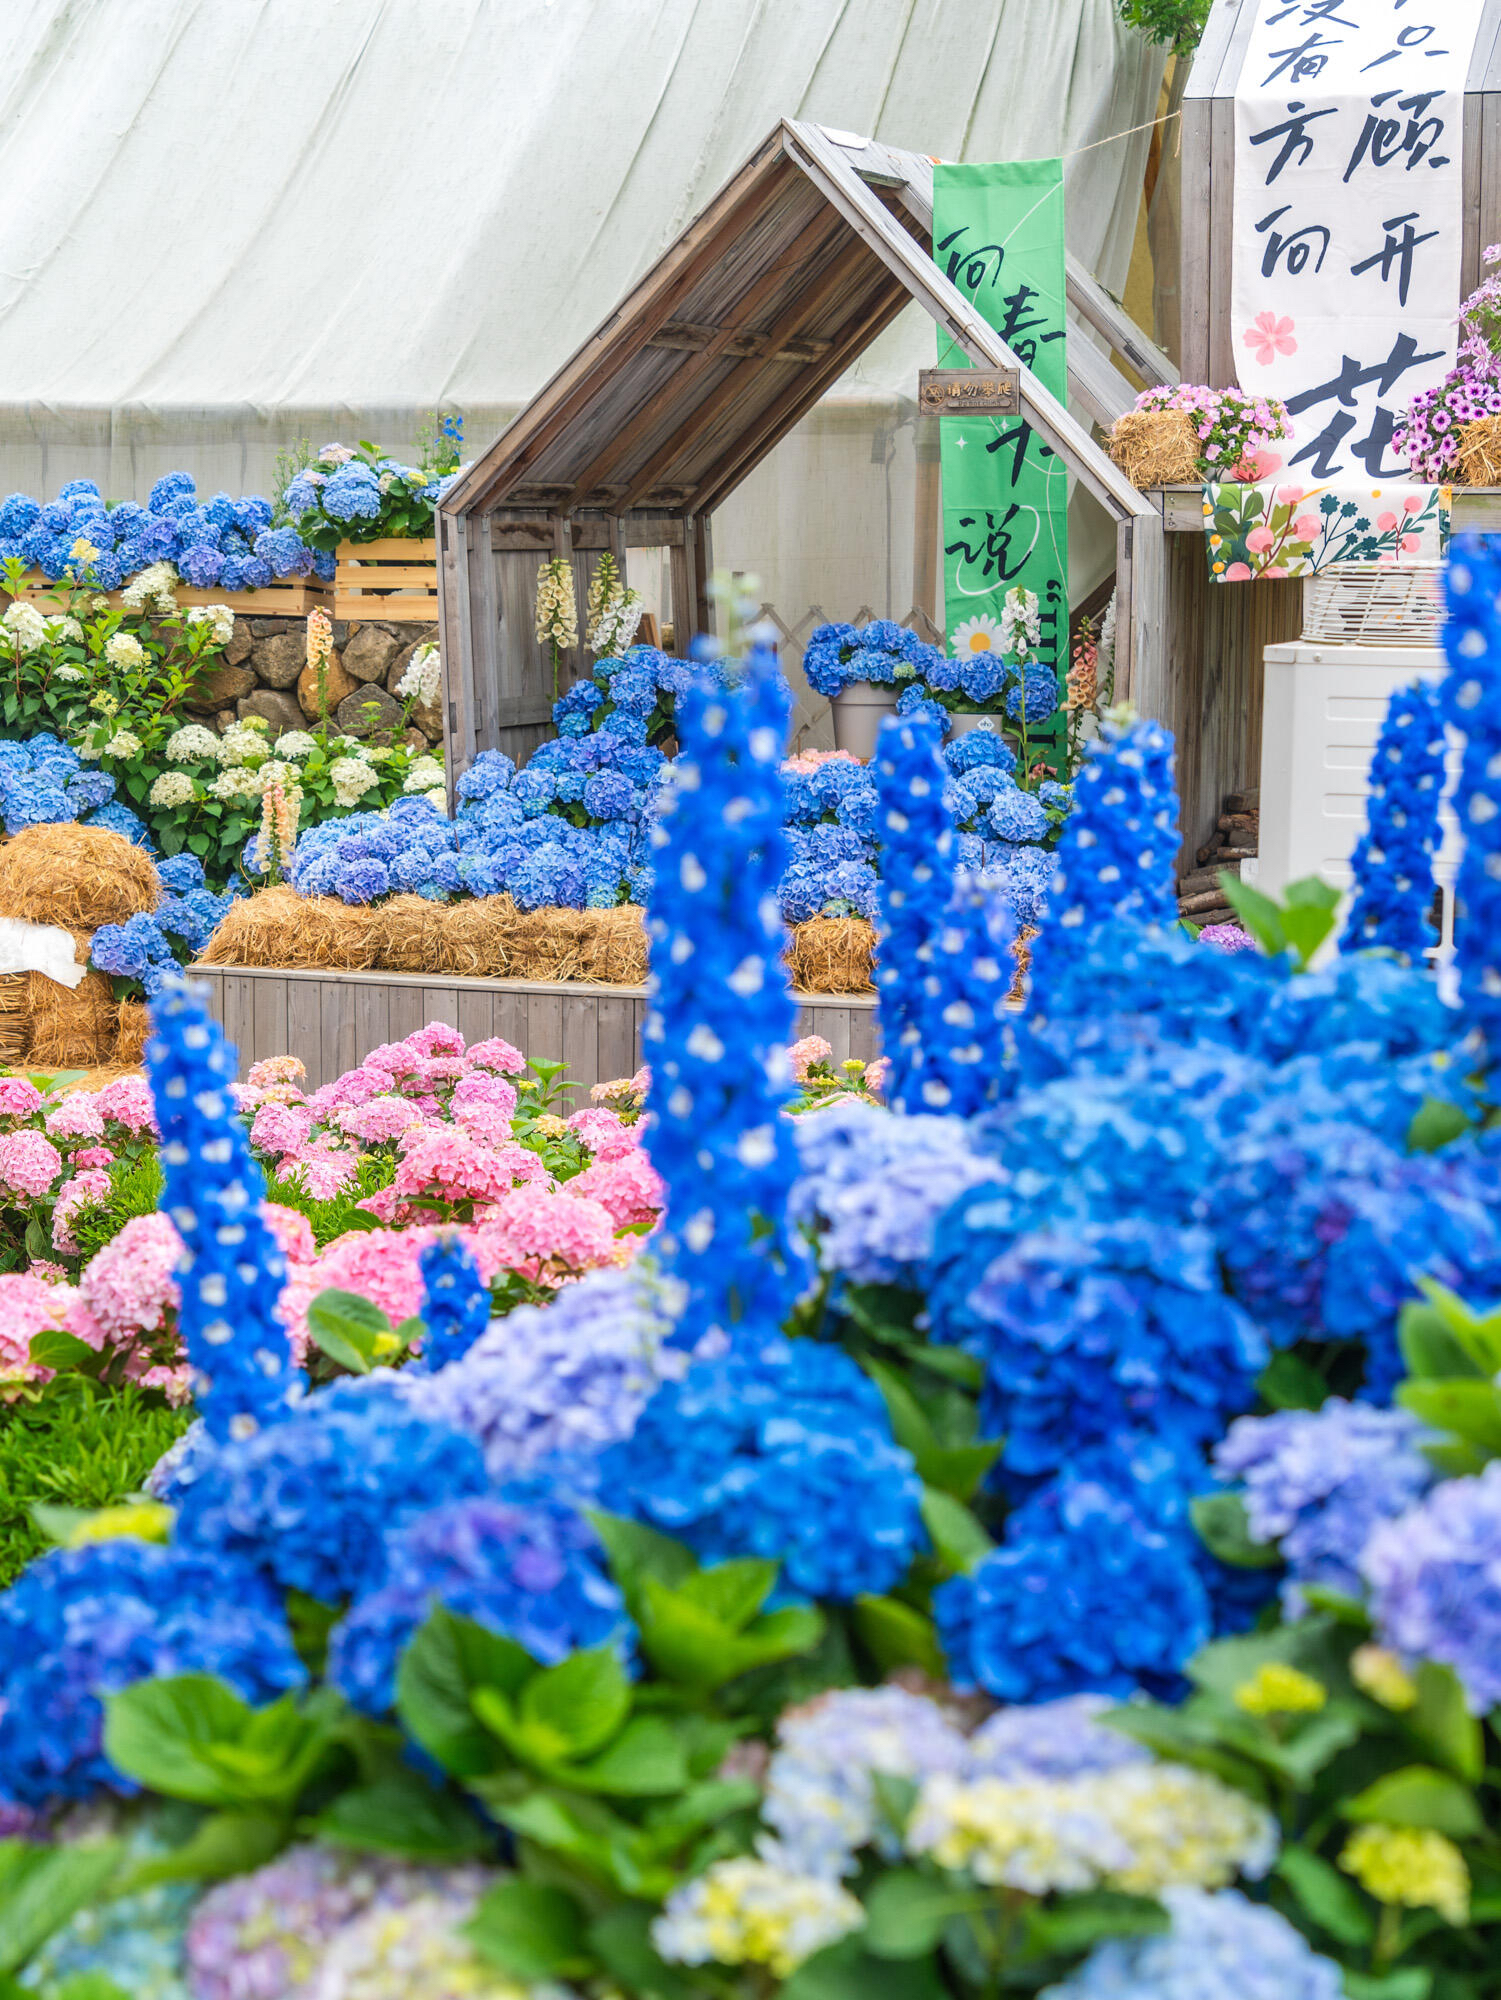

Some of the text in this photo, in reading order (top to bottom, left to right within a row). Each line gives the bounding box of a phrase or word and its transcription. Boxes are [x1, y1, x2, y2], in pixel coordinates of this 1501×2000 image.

[1286, 0, 1451, 480] 只顾开花
[947, 381, 1012, 397] 请勿攀爬
